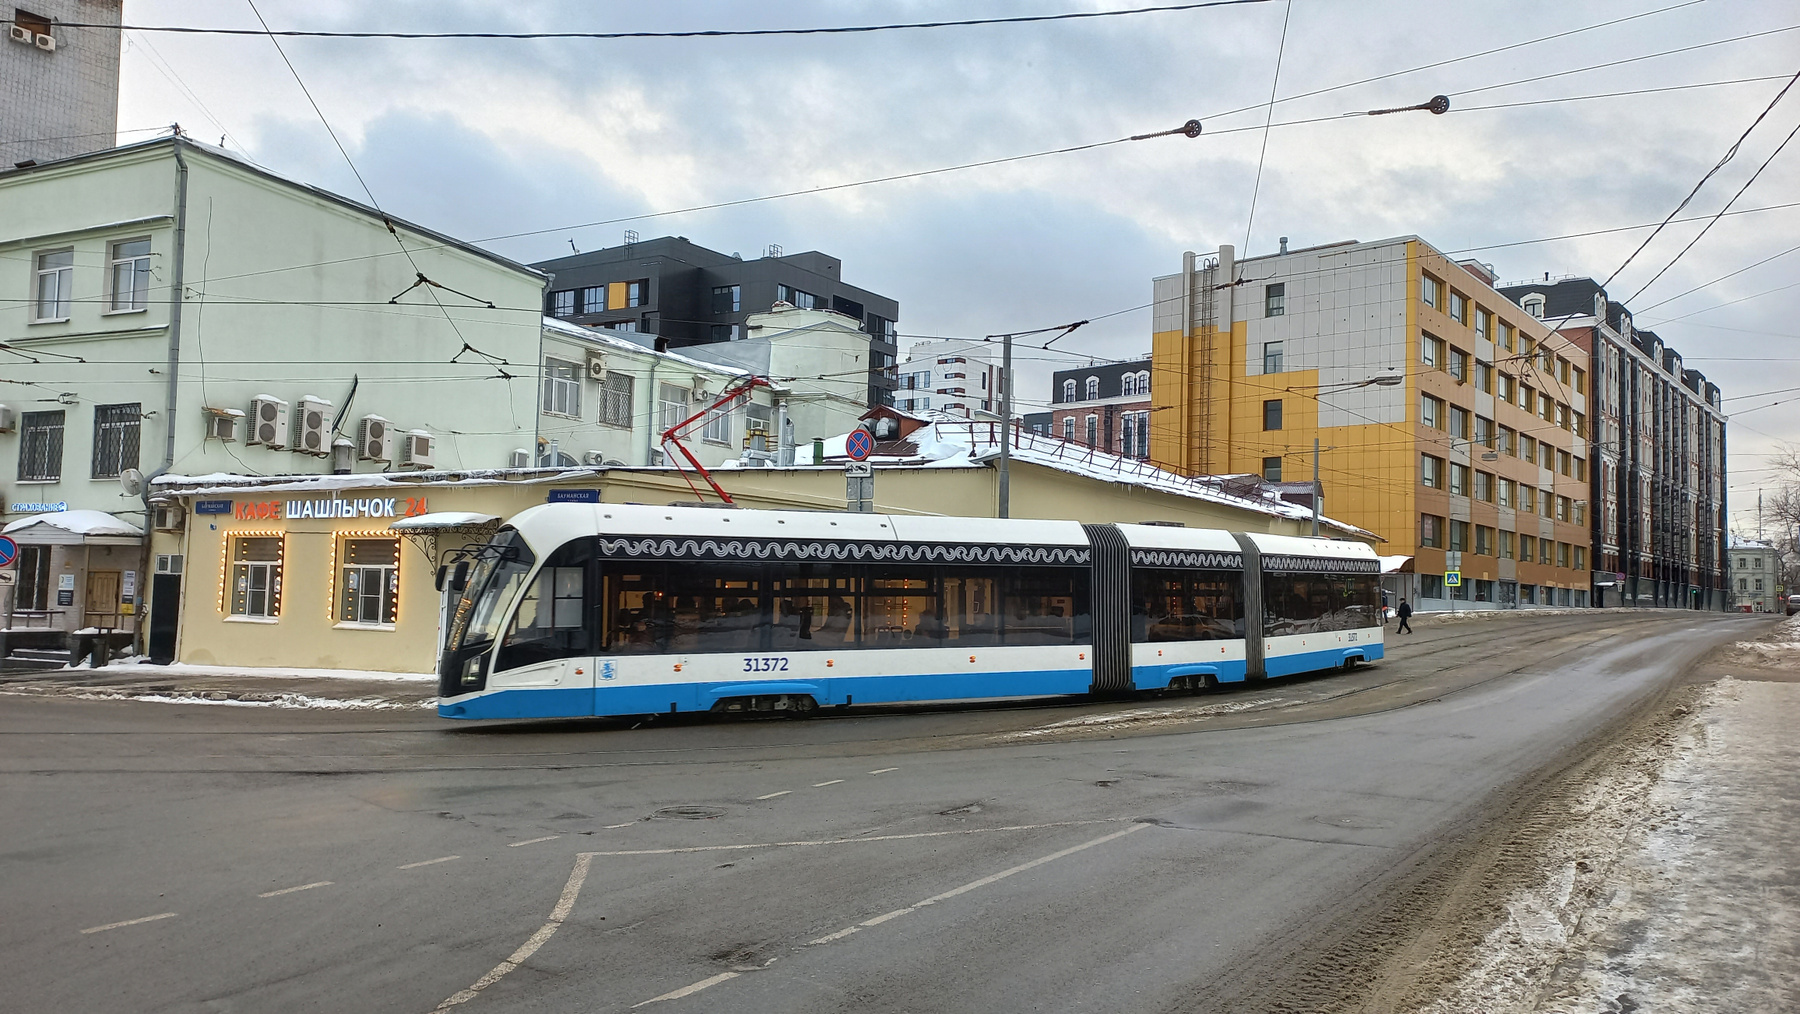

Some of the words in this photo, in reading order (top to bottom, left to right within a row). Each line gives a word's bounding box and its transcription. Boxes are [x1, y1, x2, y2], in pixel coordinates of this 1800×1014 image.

[235, 501, 281, 520] КАФЕ
[286, 498, 396, 518] ШАШЛЫЧОК
[405, 497, 428, 516] 24
[743, 657, 789, 672] 31372
